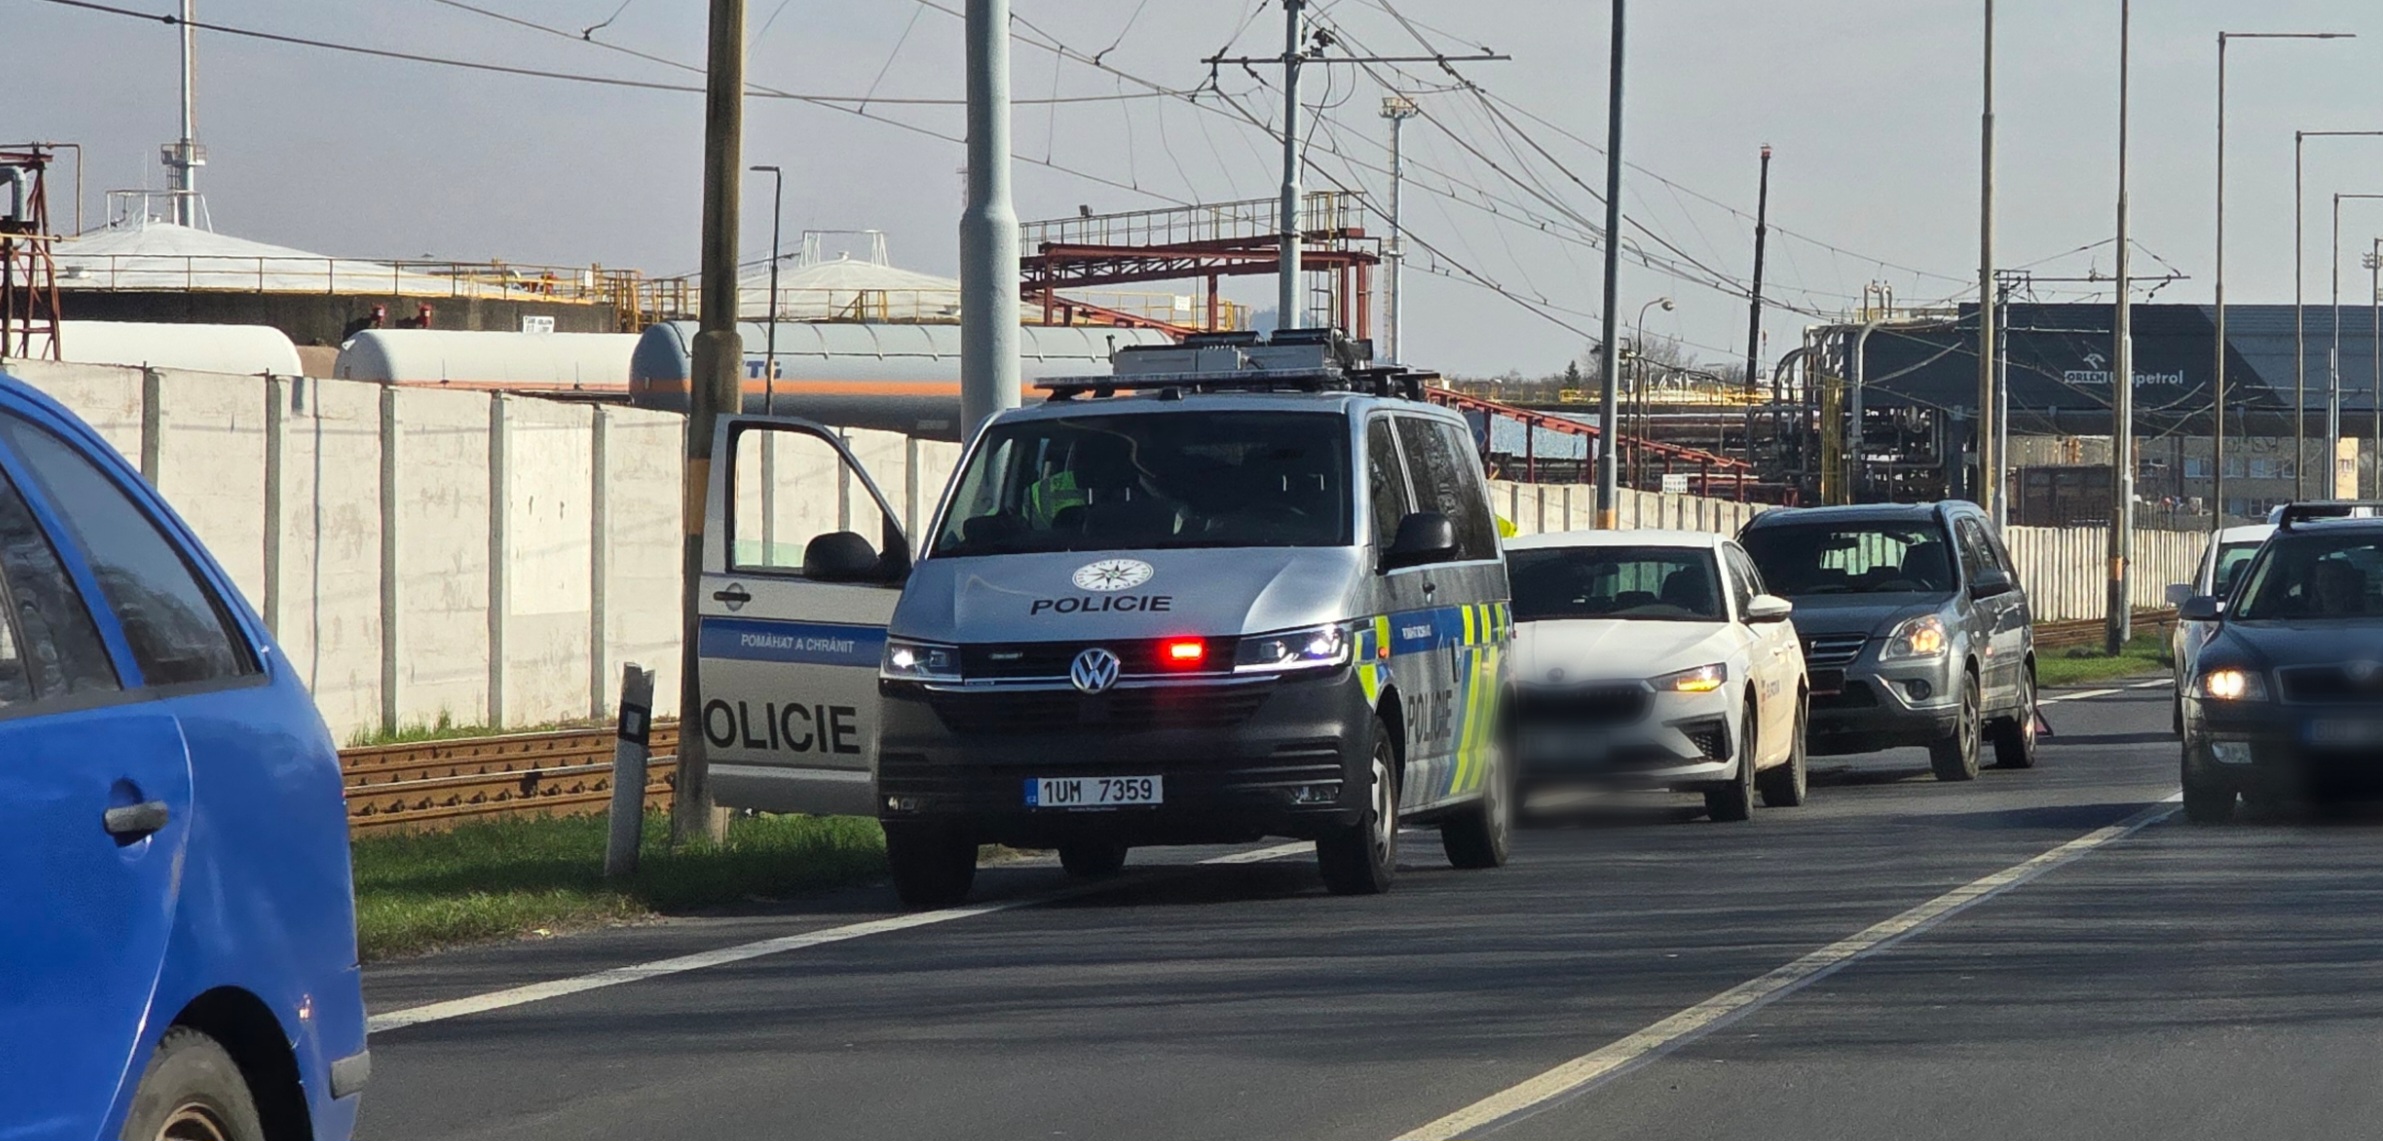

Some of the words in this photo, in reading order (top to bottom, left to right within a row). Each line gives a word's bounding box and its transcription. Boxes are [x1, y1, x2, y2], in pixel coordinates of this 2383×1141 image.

[2065, 371, 2106, 383] ORLEN
[2109, 370, 2183, 388] Uipetrol
[1030, 595, 1172, 615] POLICIE
[741, 633, 794, 649] POMÁHAT
[795, 638, 803, 650] A
[806, 636, 855, 653] CHRÁNIT
[703, 699, 861, 754] OLICIE
[1406, 690, 1453, 745] POLICIE
[1044, 780, 1081, 803] 1UM
[1099, 779, 1152, 802] 7359
